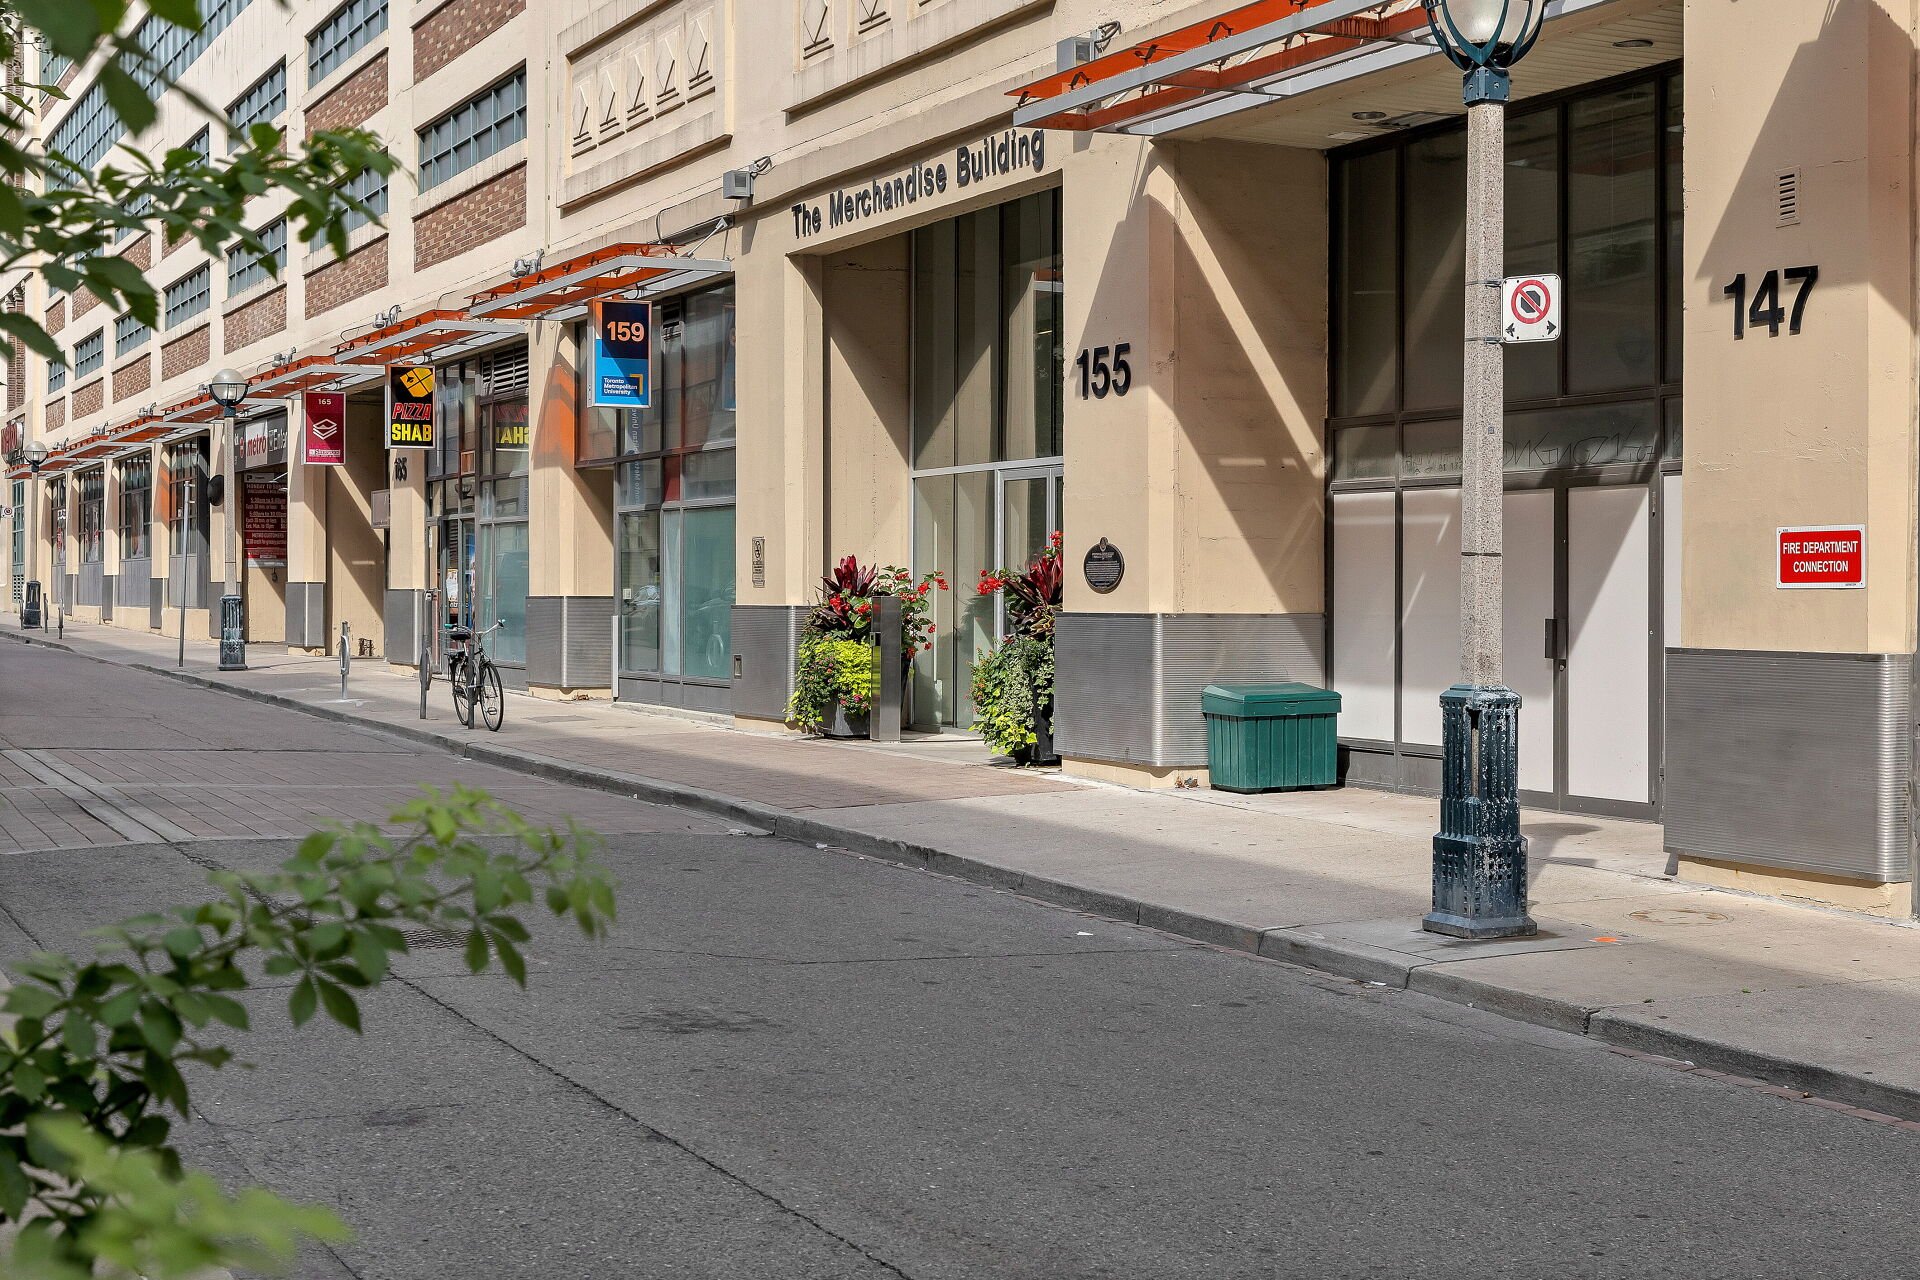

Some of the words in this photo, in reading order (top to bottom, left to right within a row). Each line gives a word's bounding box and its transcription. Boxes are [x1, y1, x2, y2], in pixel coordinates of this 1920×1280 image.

[791, 203, 822, 239] The
[829, 163, 947, 229] Merchandise
[956, 128, 1045, 188] Building
[1723, 265, 1819, 340] 147
[607, 321, 645, 342] 159
[1076, 342, 1131, 400] 155
[603, 383, 638, 391] Metropolitan
[603, 388, 632, 396] University
[391, 402, 432, 421] PIZZA
[391, 423, 432, 442] SHAB
[247, 434, 267, 457] metro
[1782, 542, 1801, 554] FIRE
[1803, 541, 1859, 554] DEPARTMENT
[1793, 560, 1849, 573] CONNECTION
